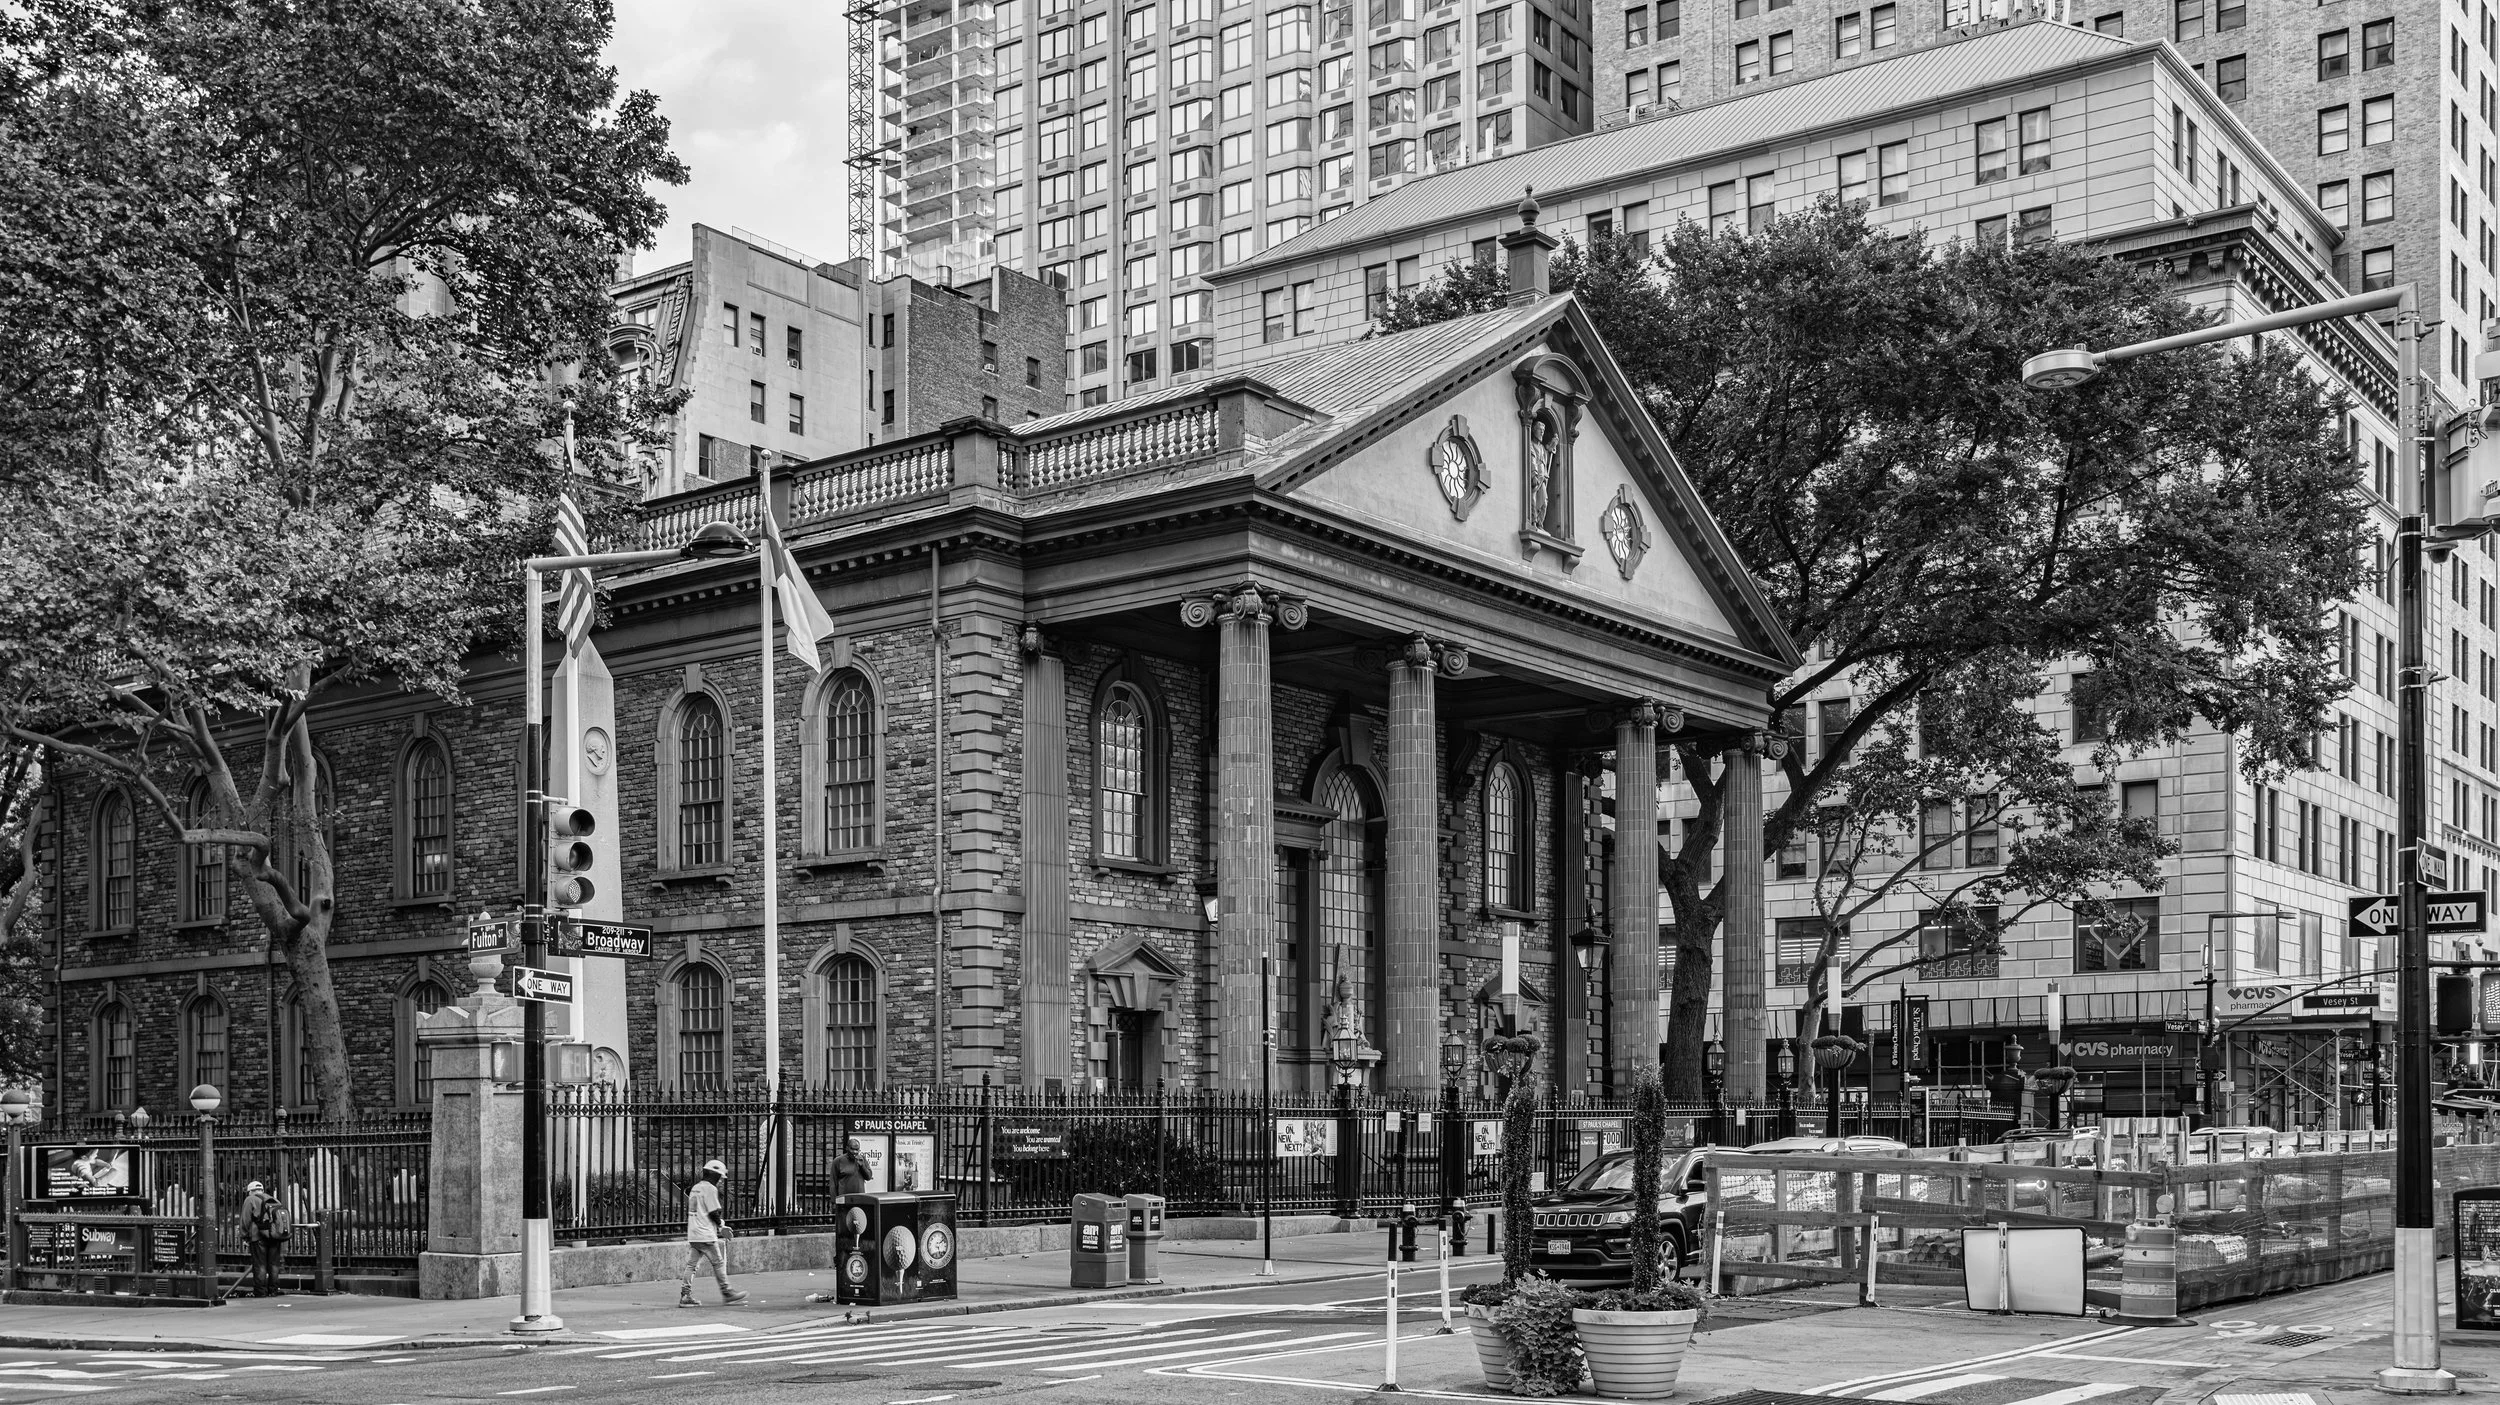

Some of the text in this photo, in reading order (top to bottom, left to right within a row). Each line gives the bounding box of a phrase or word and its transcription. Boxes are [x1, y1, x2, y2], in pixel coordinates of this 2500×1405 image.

[2369, 904, 2468, 925] ON WAY
[602, 926, 625, 936] 209-211
[472, 931, 498, 949] Fulton
[587, 931, 645, 953] Broadway
[527, 978, 568, 994] ONE WAY
[2243, 987, 2276, 1000] CVS
[2323, 997, 2358, 1007] Vesey St
[2167, 1022, 2185, 1032] Vesey
[1911, 1036, 1921, 1061] Chapel
[2075, 1041, 2174, 1059] CVS pharmacy
[865, 1120, 893, 1130] PAUL'S
[894, 1120, 928, 1130] CHAPEL
[1001, 1126, 1011, 1134] You
[1026, 1135, 1035, 1143] You
[1012, 1144, 1050, 1153] You belong here
[1285, 1143, 1302, 1151] NEXT?
[859, 1149, 883, 1160] orship
[81, 1227, 116, 1245] Subway
